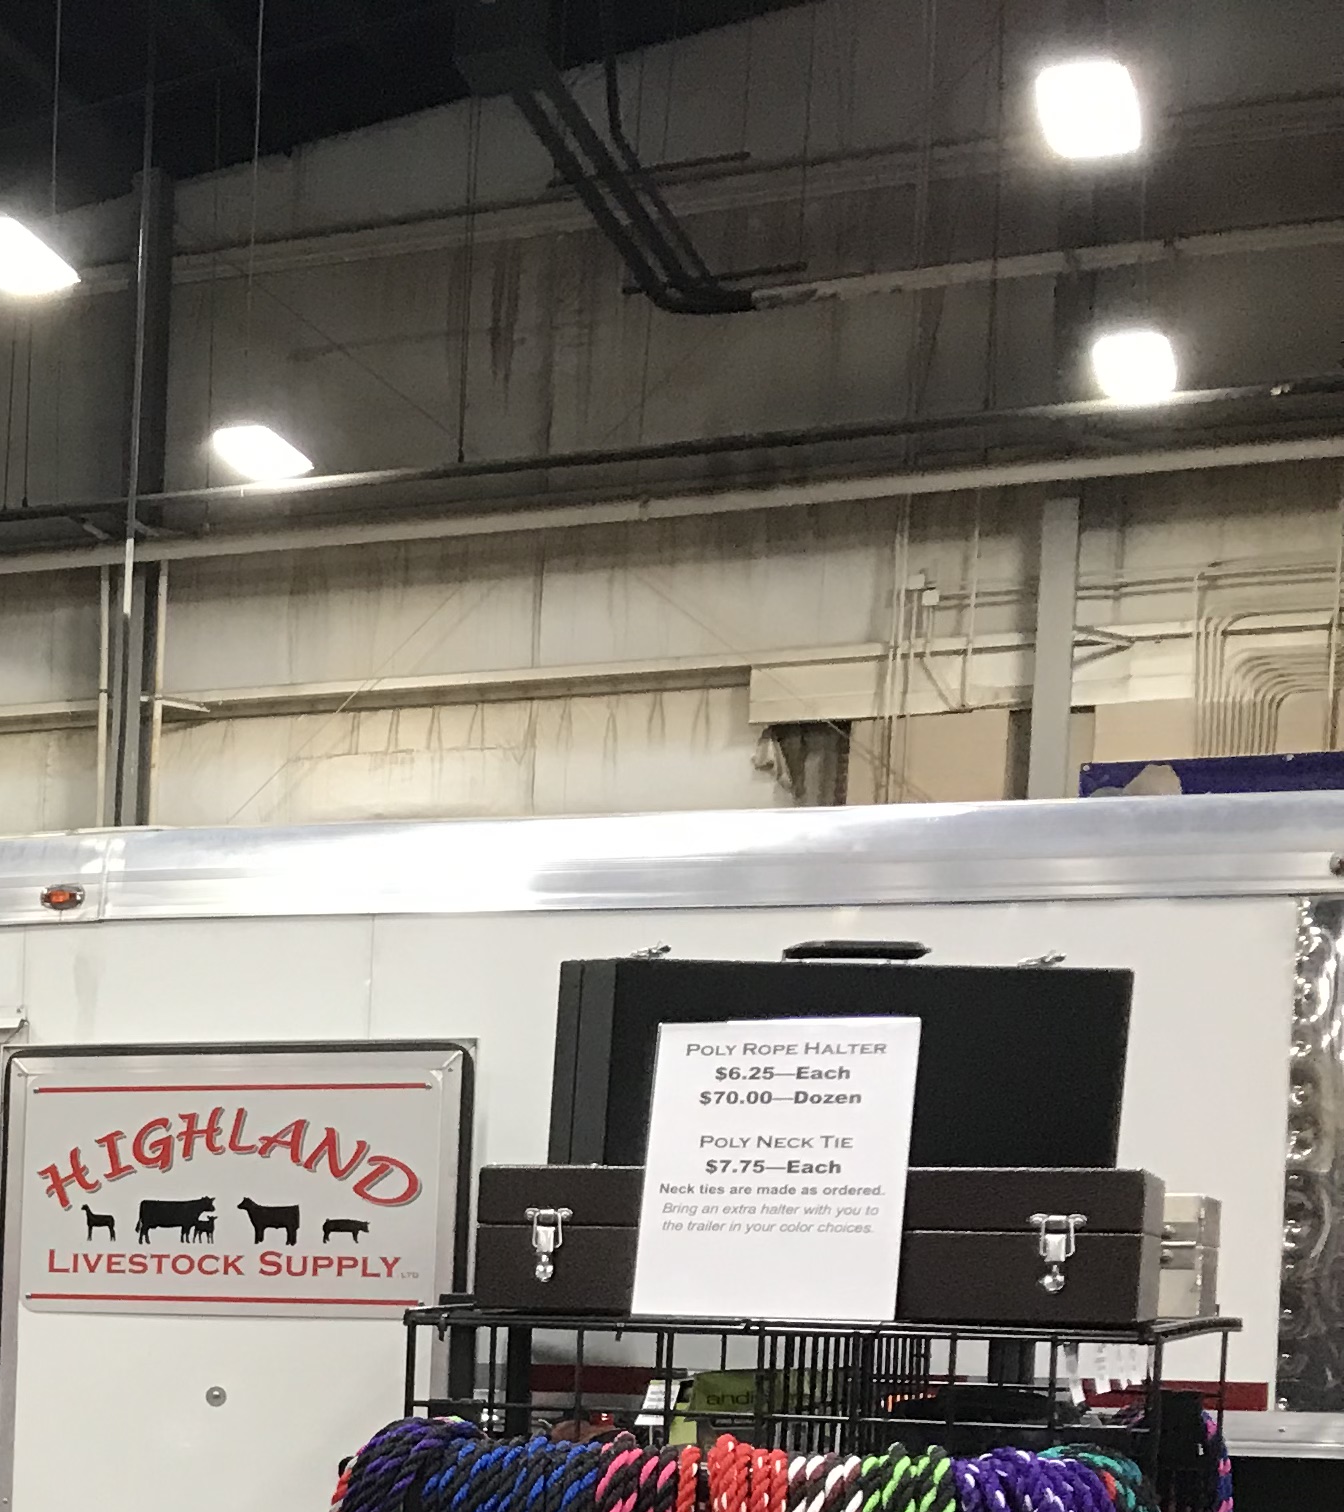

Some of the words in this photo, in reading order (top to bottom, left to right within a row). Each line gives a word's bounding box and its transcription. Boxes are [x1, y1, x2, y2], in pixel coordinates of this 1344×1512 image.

[686, 1042, 736, 1056] POLY
[742, 1042, 799, 1056] ROPE
[803, 1041, 888, 1055] HALTER
[699, 1135, 752, 1149] POLY
[756, 1135, 815, 1149] NECK
[819, 1135, 854, 1149] TIE
[37, 1106, 422, 1210] HIGHLAND
[658, 1183, 695, 1195] Neck
[698, 1183, 725, 1195] ties
[729, 1186, 752, 1195] are
[756, 1184, 797, 1195] made
[800, 1186, 818, 1196] as
[822, 1184, 886, 1196] ordered.
[662, 1202, 698, 1216] Bring
[701, 1205, 719, 1214] an
[722, 1204, 757, 1215] extra
[761, 1203, 800, 1216] halter
[803, 1203, 832, 1216] with
[835, 1206, 862, 1218] you
[865, 1205, 880, 1216] to
[662, 1220, 683, 1231] the
[687, 1220, 725, 1232] trailer
[728, 1220, 741, 1232] in
[744, 1223, 776, 1235] your
[779, 1221, 814, 1233] color
[817, 1222, 875, 1234] choices.
[47, 1248, 244, 1277] LIVESTOCK
[258, 1250, 403, 1279] SUPPLY
